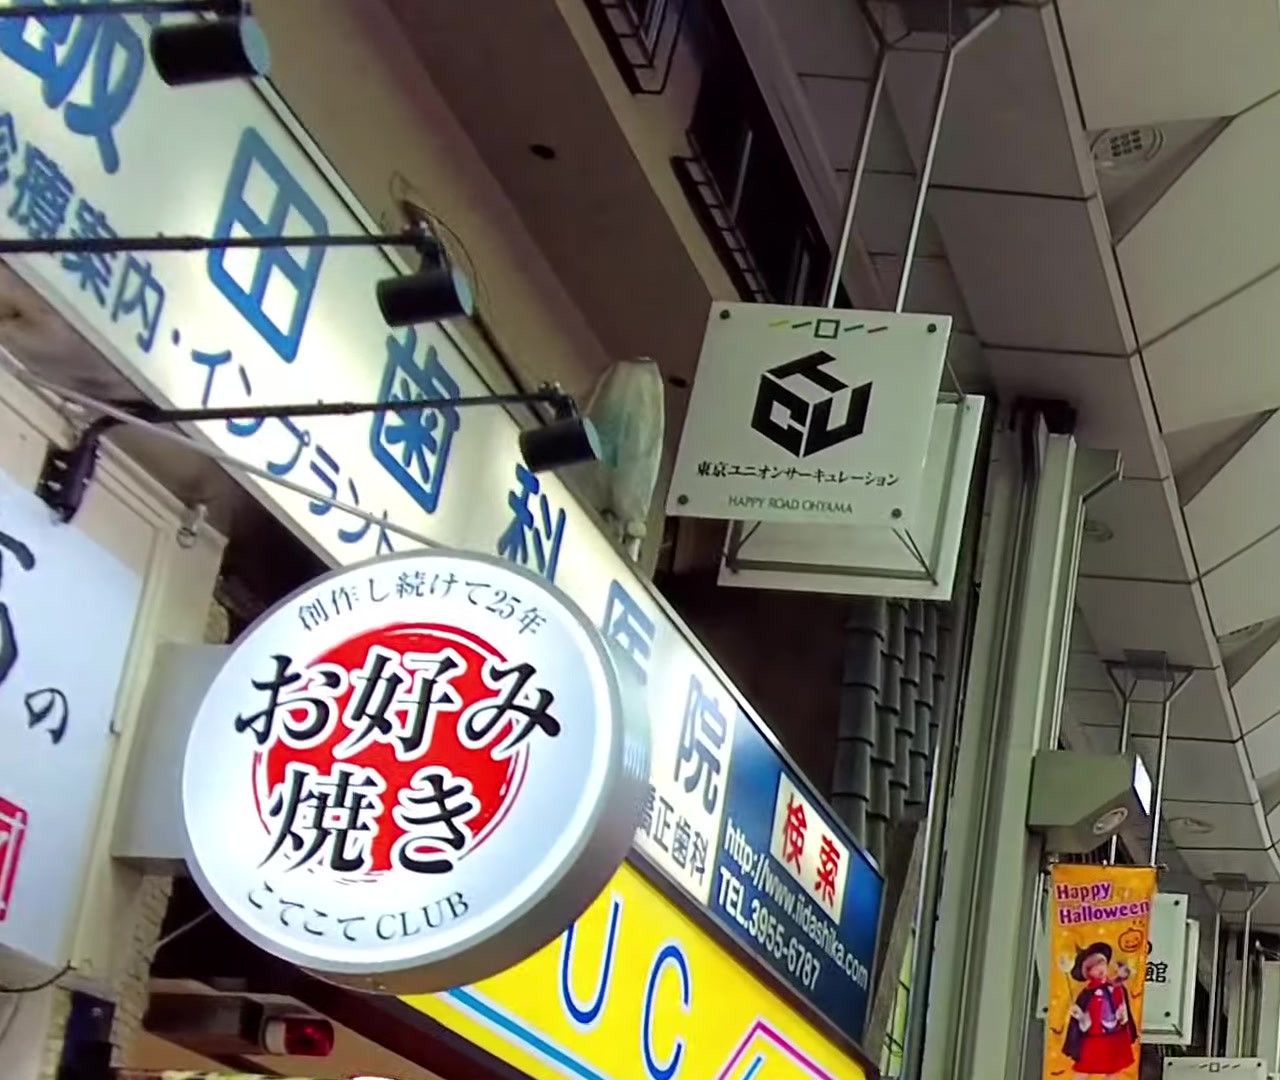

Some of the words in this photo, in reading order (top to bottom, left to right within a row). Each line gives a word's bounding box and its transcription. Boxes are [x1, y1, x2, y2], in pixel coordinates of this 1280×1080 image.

[697, 460, 900, 487] 東京ユニオンサーキュレーション
[728, 495, 765, 509] HAPPY
[768, 497, 800, 511] ROAD
[801, 499, 854, 514] OHYAMA
[297, 570, 549, 636] 創作し続けて25年
[24, 687, 69, 744] の
[233, 652, 562, 755] お好み
[257, 768, 476, 875] 焼き
[781, 791, 843, 909] 検索
[724, 817, 869, 991] http://www.iidashika.com
[1056, 882, 1112, 903] Happy
[1058, 901, 1151, 926] Halloween
[717, 867, 822, 991] TEL.3955-6787
